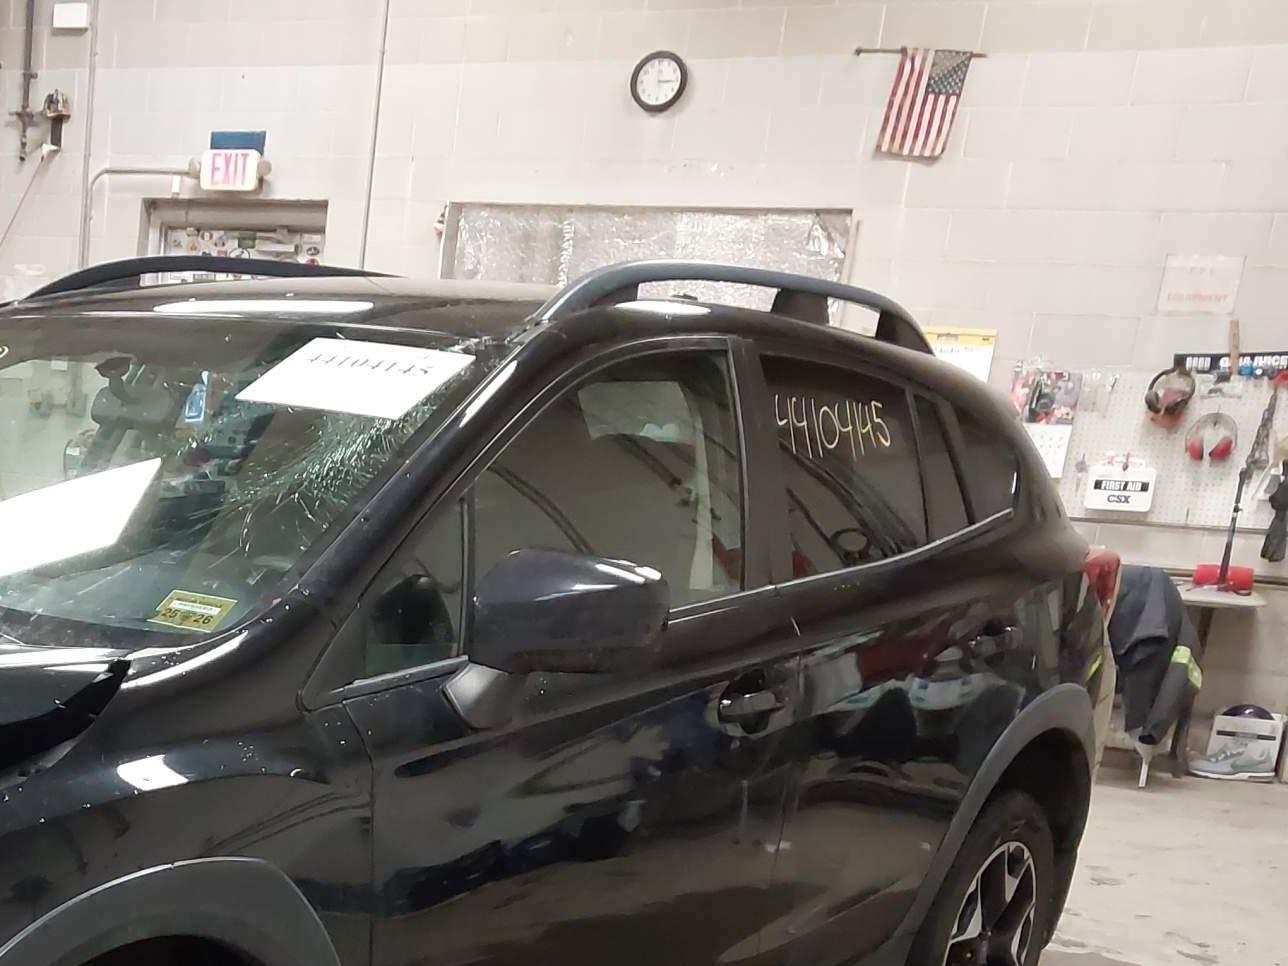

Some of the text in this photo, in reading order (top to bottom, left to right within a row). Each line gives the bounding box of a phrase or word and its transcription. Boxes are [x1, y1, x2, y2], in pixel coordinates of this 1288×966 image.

[211, 152, 249, 186] EXIT
[775, 394, 891, 461] 44104145
[1101, 480, 1142, 492] FIRST AID
[1107, 494, 1131, 504] CSX
[161, 608, 214, 625] 25 26
